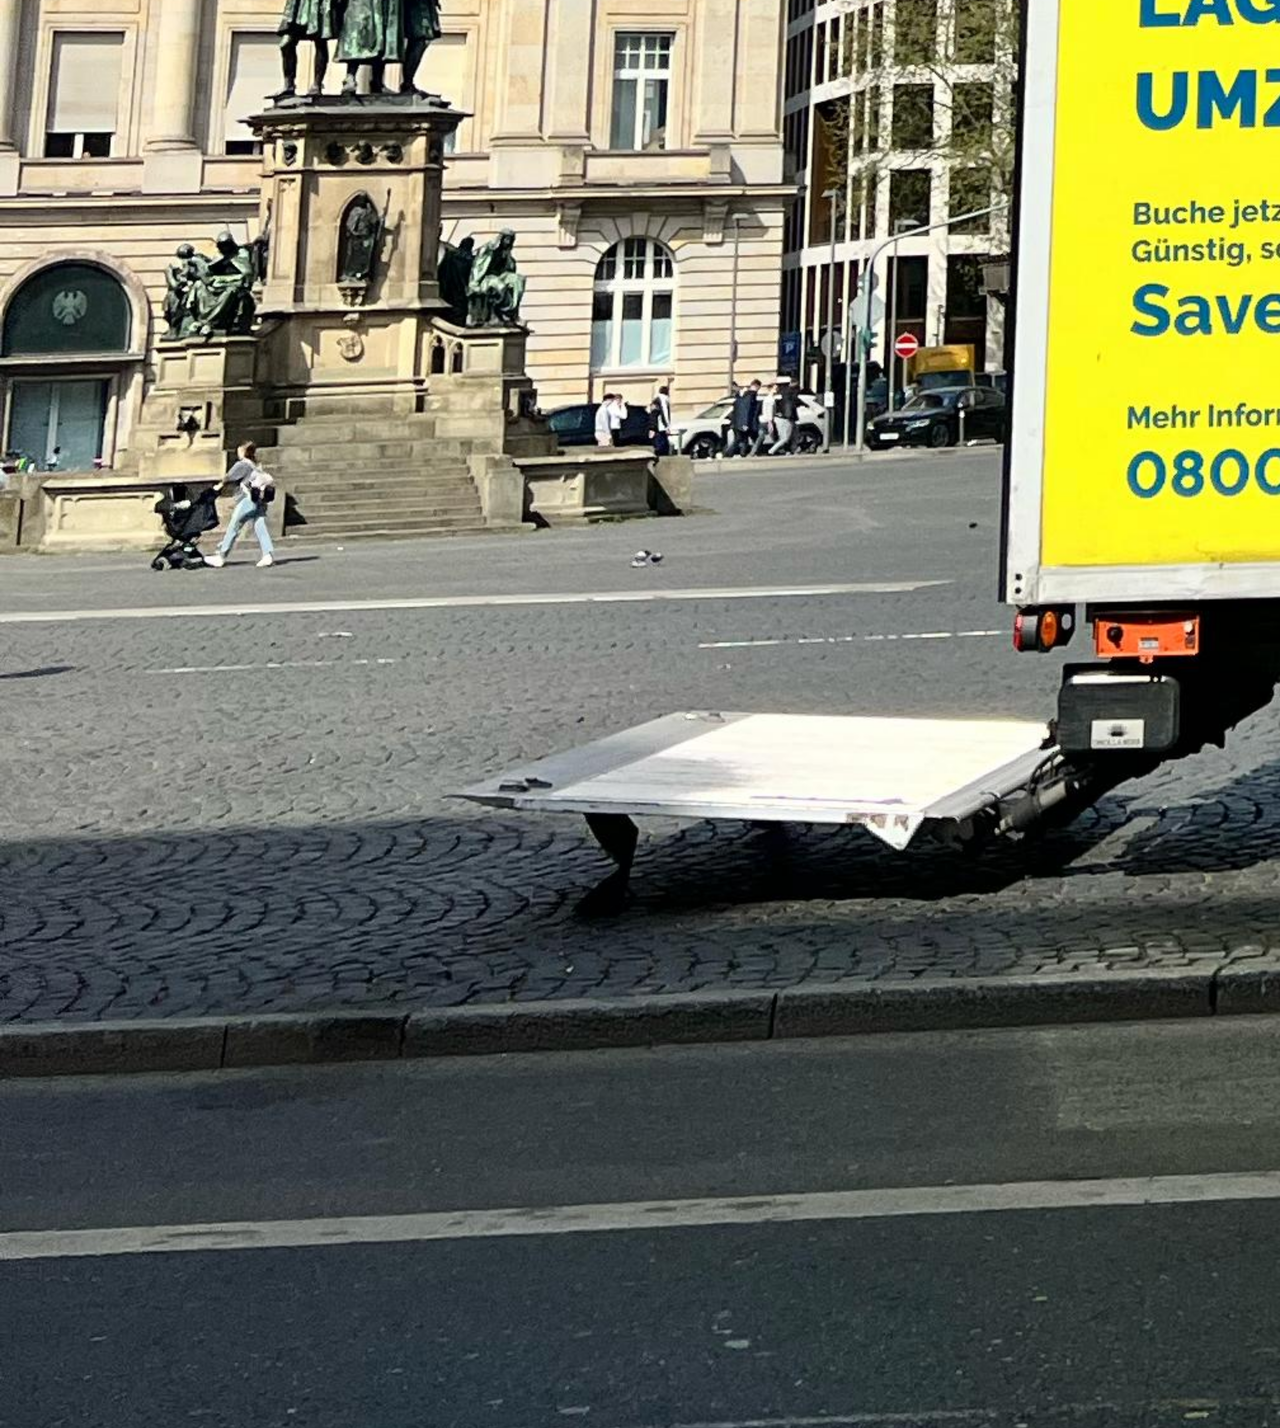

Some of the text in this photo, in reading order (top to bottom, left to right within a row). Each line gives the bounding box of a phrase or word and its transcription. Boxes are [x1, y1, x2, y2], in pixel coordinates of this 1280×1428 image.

[1133, 200, 1226, 226] Buche
[1131, 236, 1253, 267] Günstig,
[1127, 404, 1201, 430] Mehr
